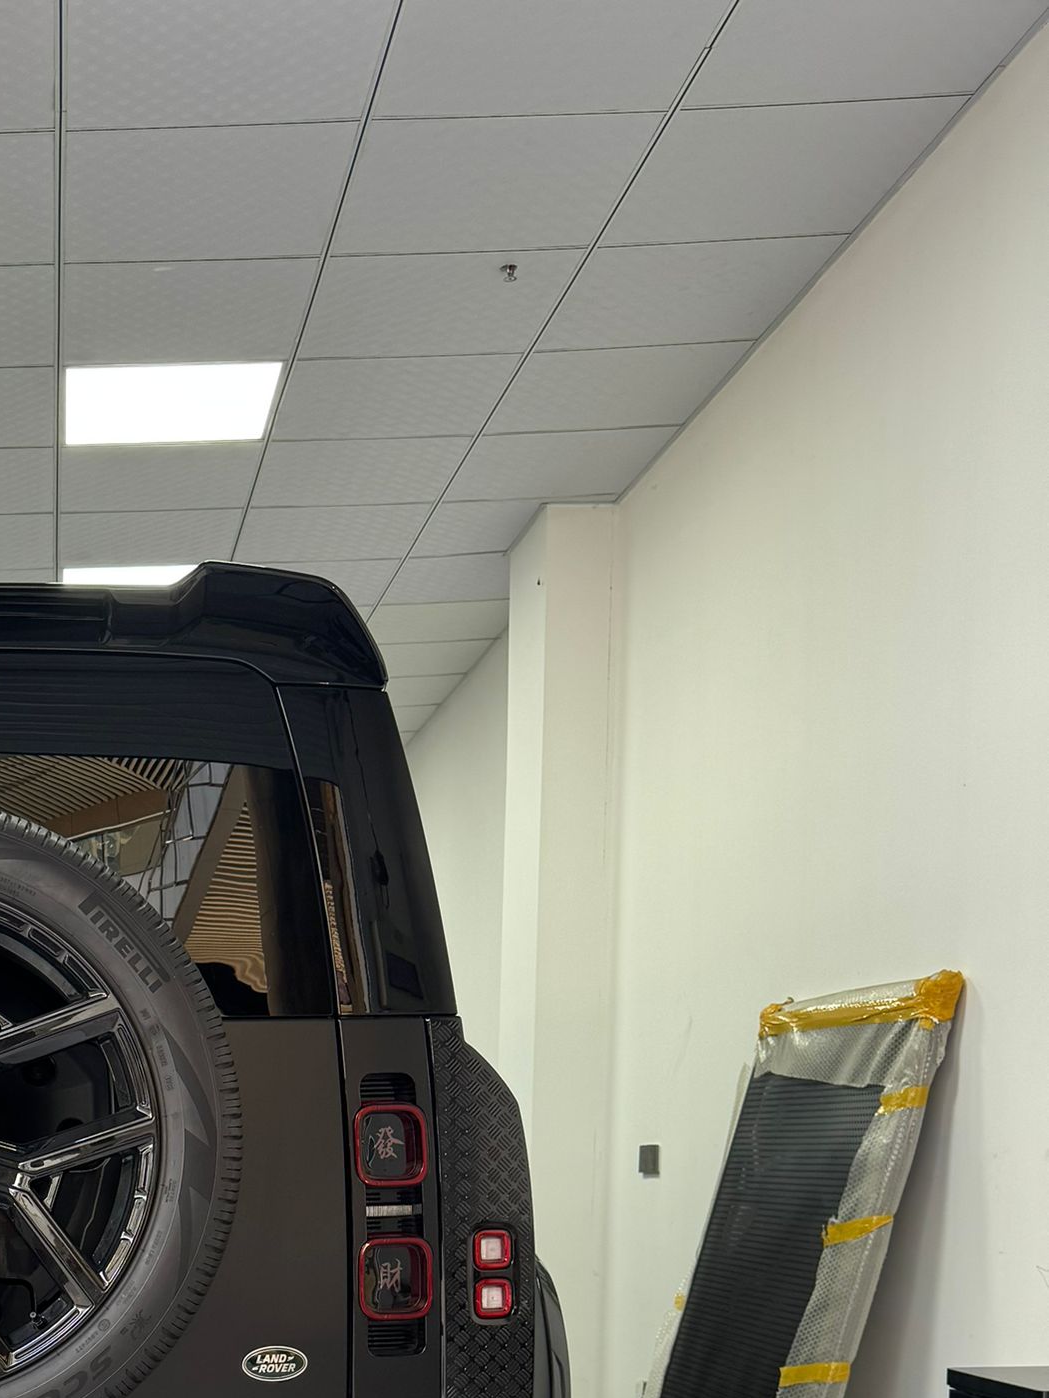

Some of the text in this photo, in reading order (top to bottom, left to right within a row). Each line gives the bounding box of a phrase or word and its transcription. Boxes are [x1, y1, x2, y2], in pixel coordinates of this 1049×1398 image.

[78, 890, 170, 994] PIRELLI
[374, 1127, 405, 1158] 發
[379, 1259, 402, 1292] 財
[256, 1354, 287, 1364] LAND
[258, 1363, 296, 1373] ROVER
